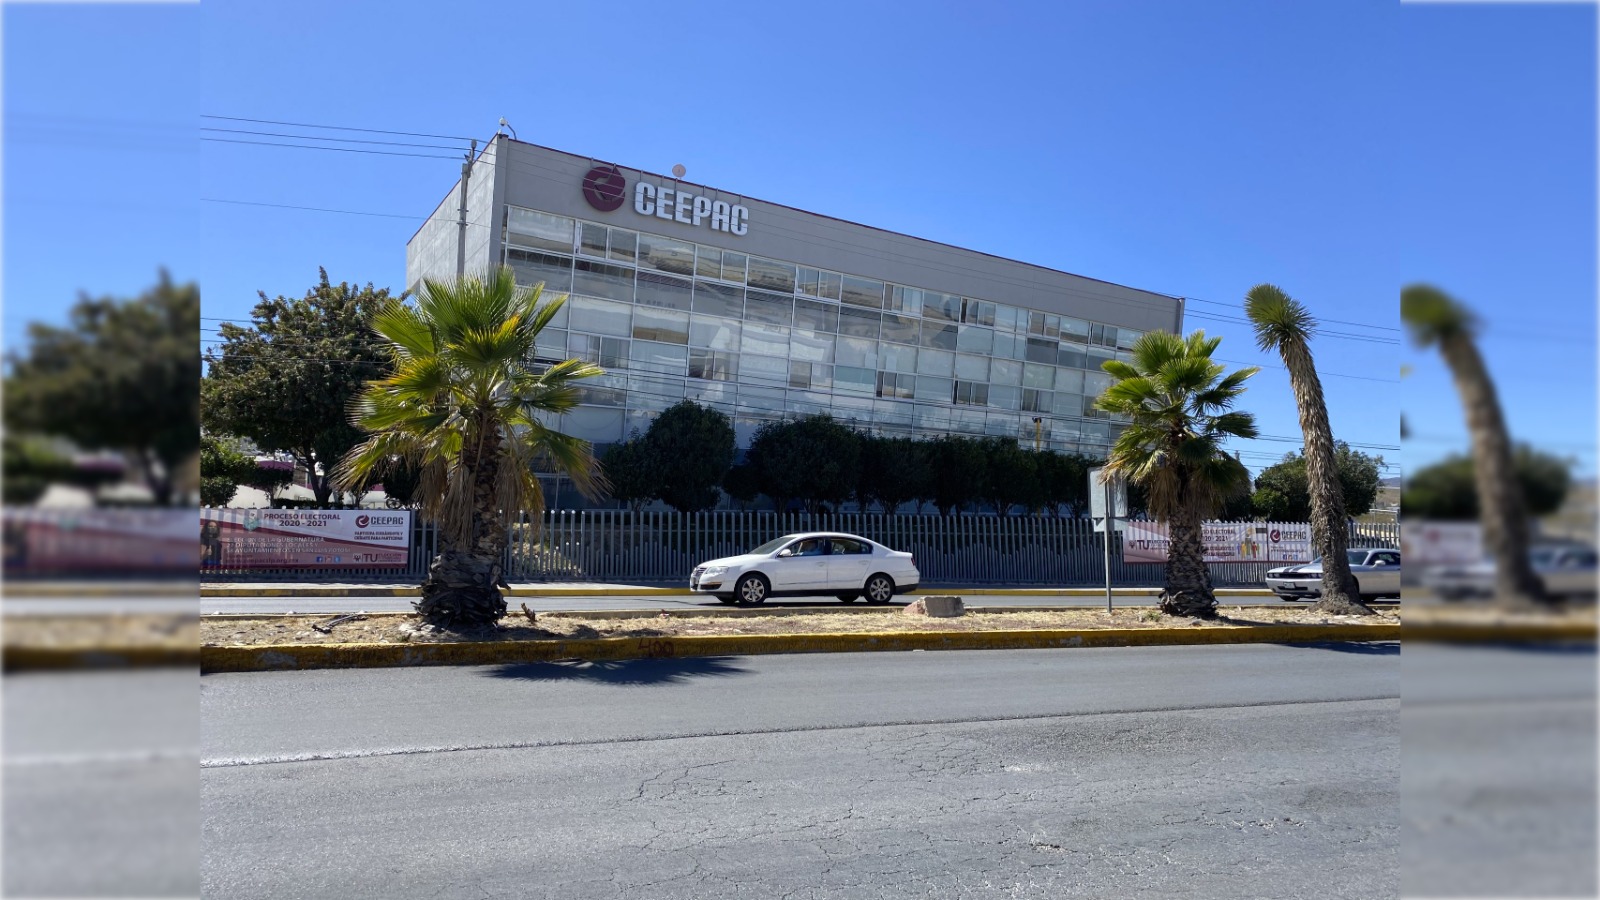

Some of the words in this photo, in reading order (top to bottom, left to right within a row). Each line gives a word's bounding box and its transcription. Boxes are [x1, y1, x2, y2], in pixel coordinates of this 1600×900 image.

[634, 181, 749, 237] CEEPAC
[370, 516, 404, 525] CEEPAC
[1281, 530, 1307, 540] CEEPAC
[1136, 539, 1149, 550] TU
[363, 553, 378, 563] TU
